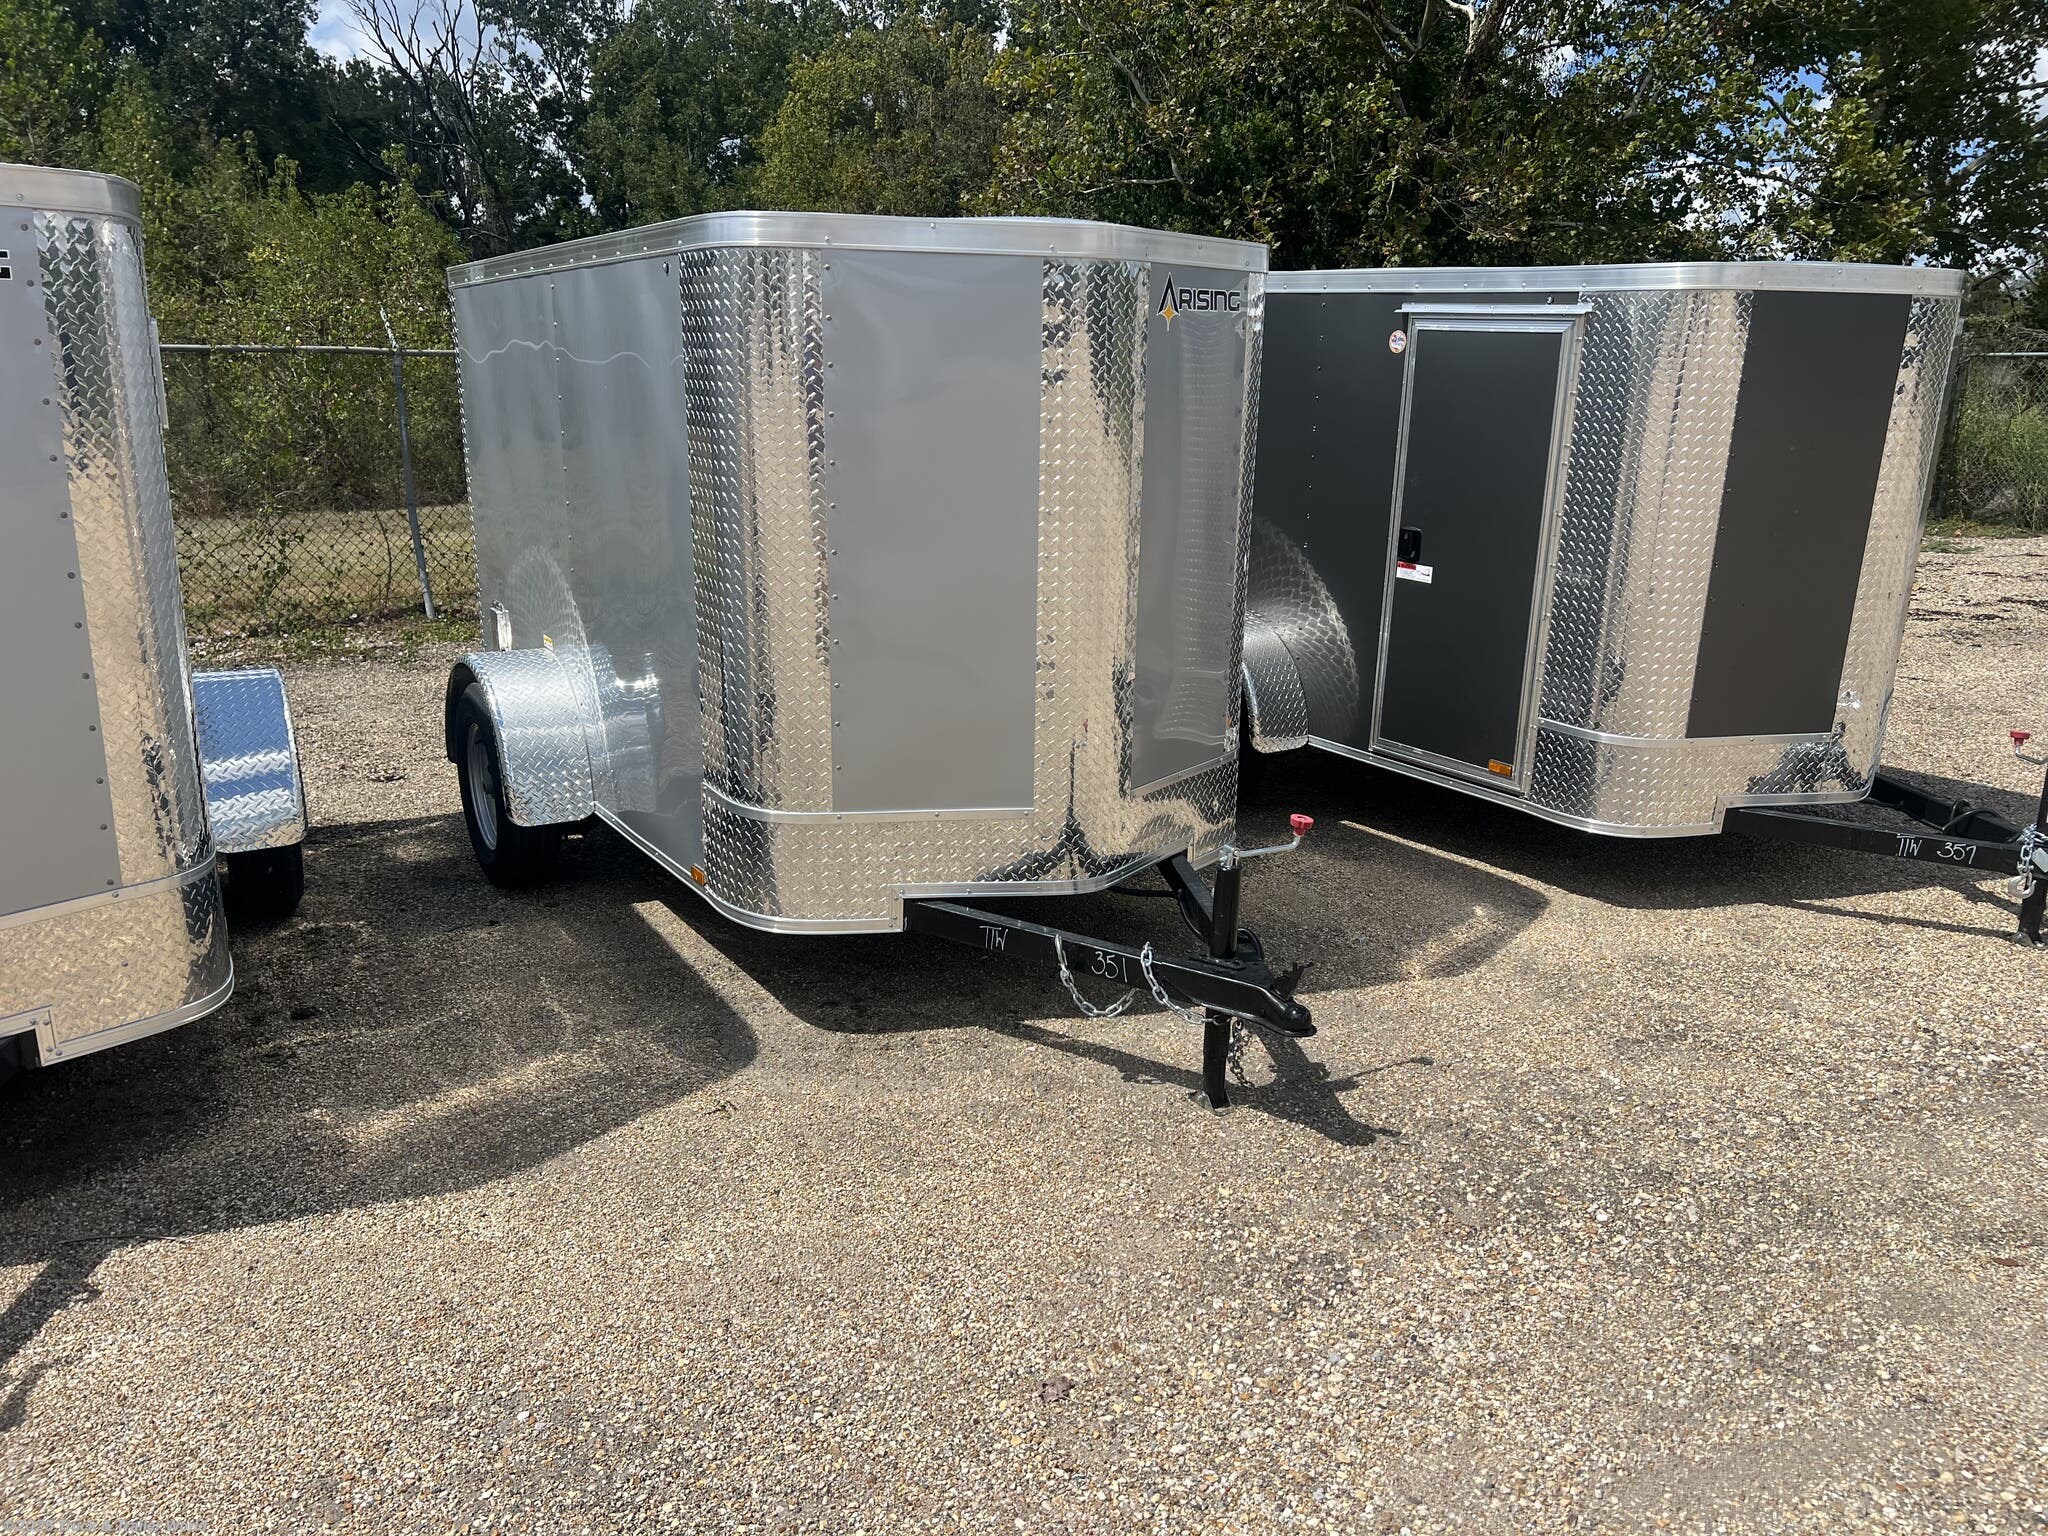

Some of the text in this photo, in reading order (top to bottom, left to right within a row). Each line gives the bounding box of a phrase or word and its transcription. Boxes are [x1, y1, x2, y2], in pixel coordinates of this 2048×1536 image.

[1936, 841, 1977, 865] 357
[979, 925, 1128, 983] TTW 351
